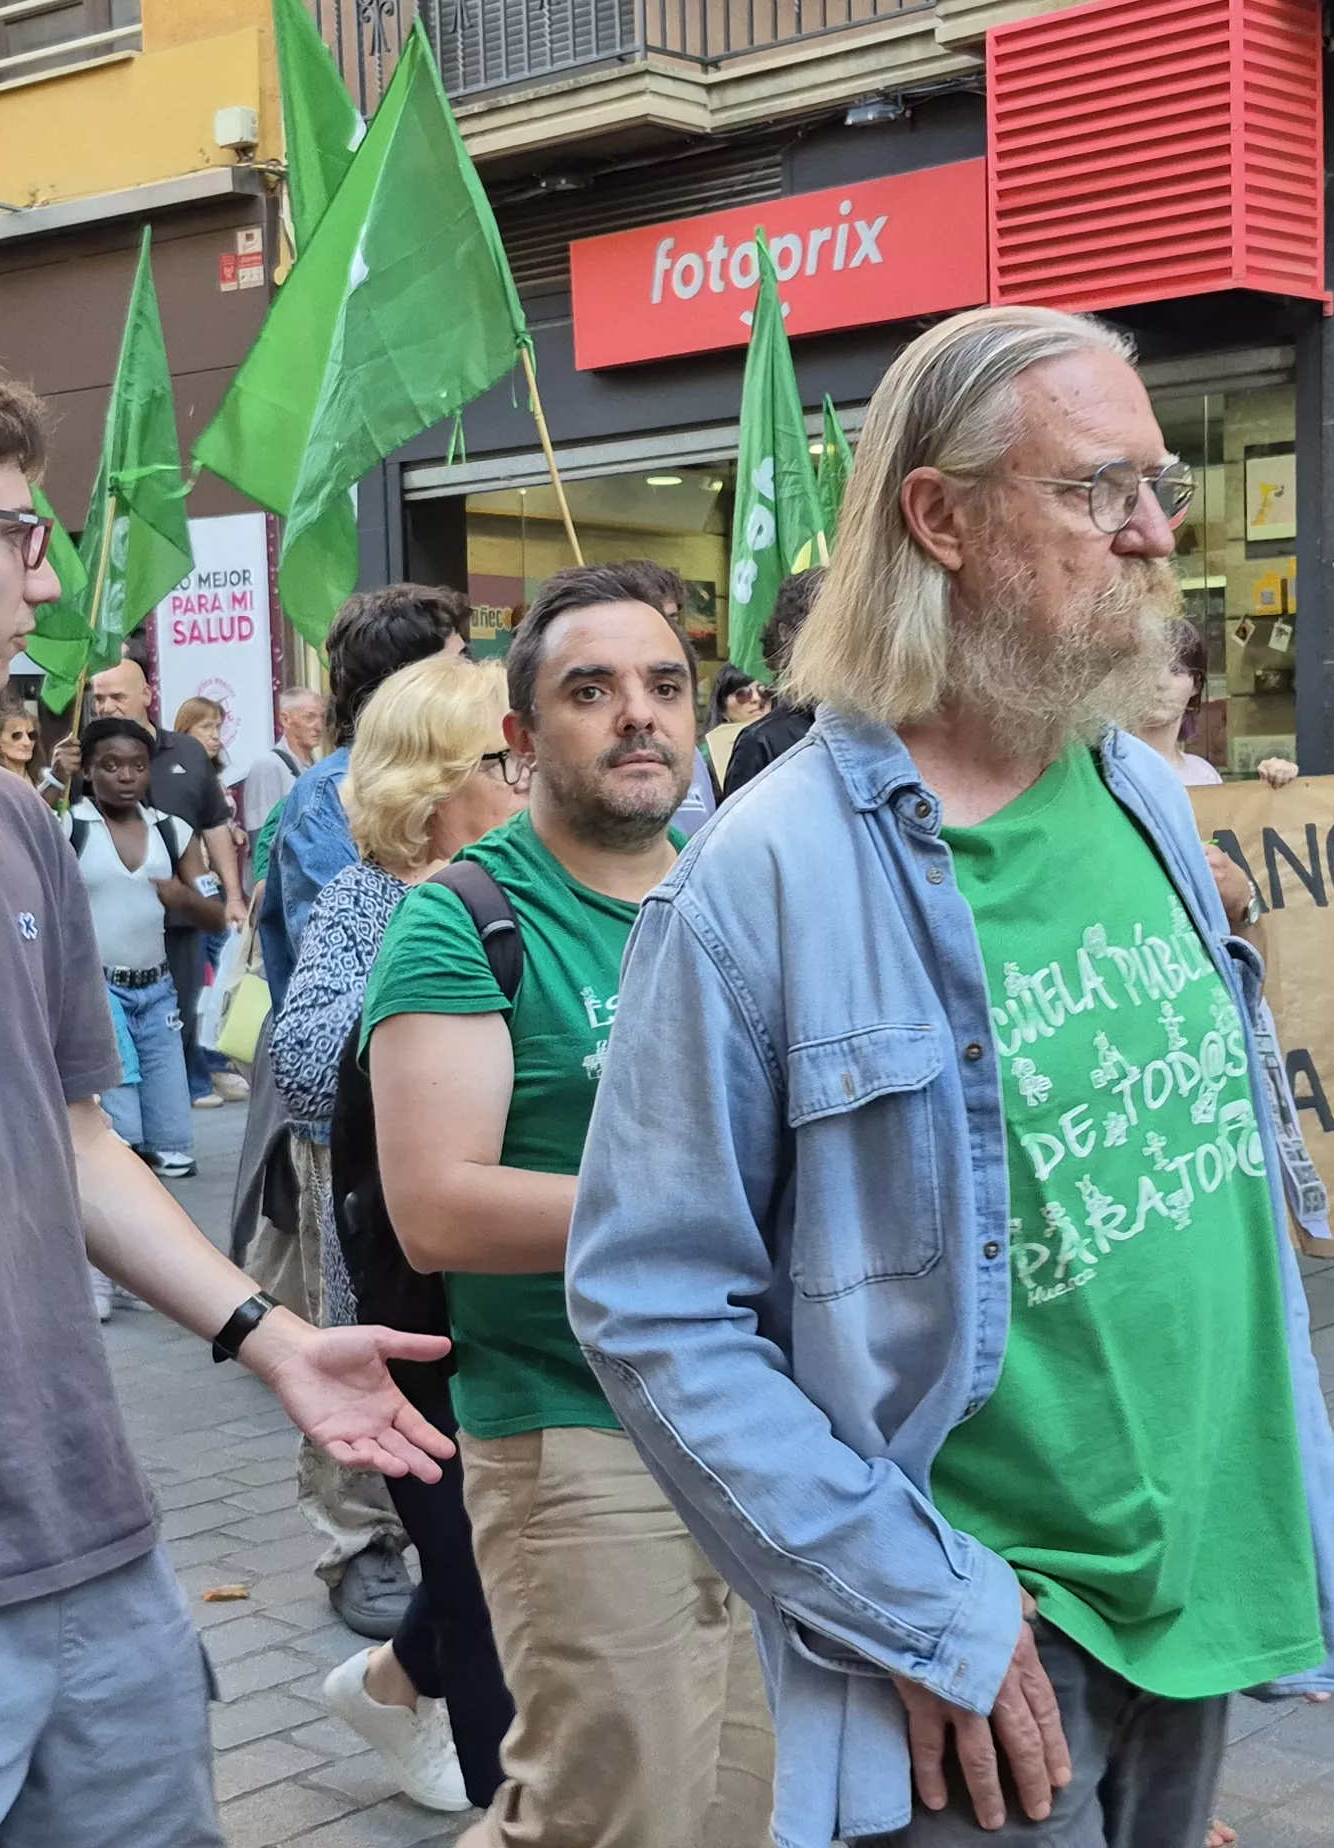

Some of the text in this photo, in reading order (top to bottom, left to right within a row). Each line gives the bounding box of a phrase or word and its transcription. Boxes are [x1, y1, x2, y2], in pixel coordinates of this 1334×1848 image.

[651, 200, 889, 304] fotoprix
[172, 591, 254, 615] PARA MI
[198, 569, 252, 589] MEJOR
[173, 615, 255, 646] SALUD
[1021, 1103, 1097, 1181] DE
[1010, 1175, 1167, 1288] PARA
